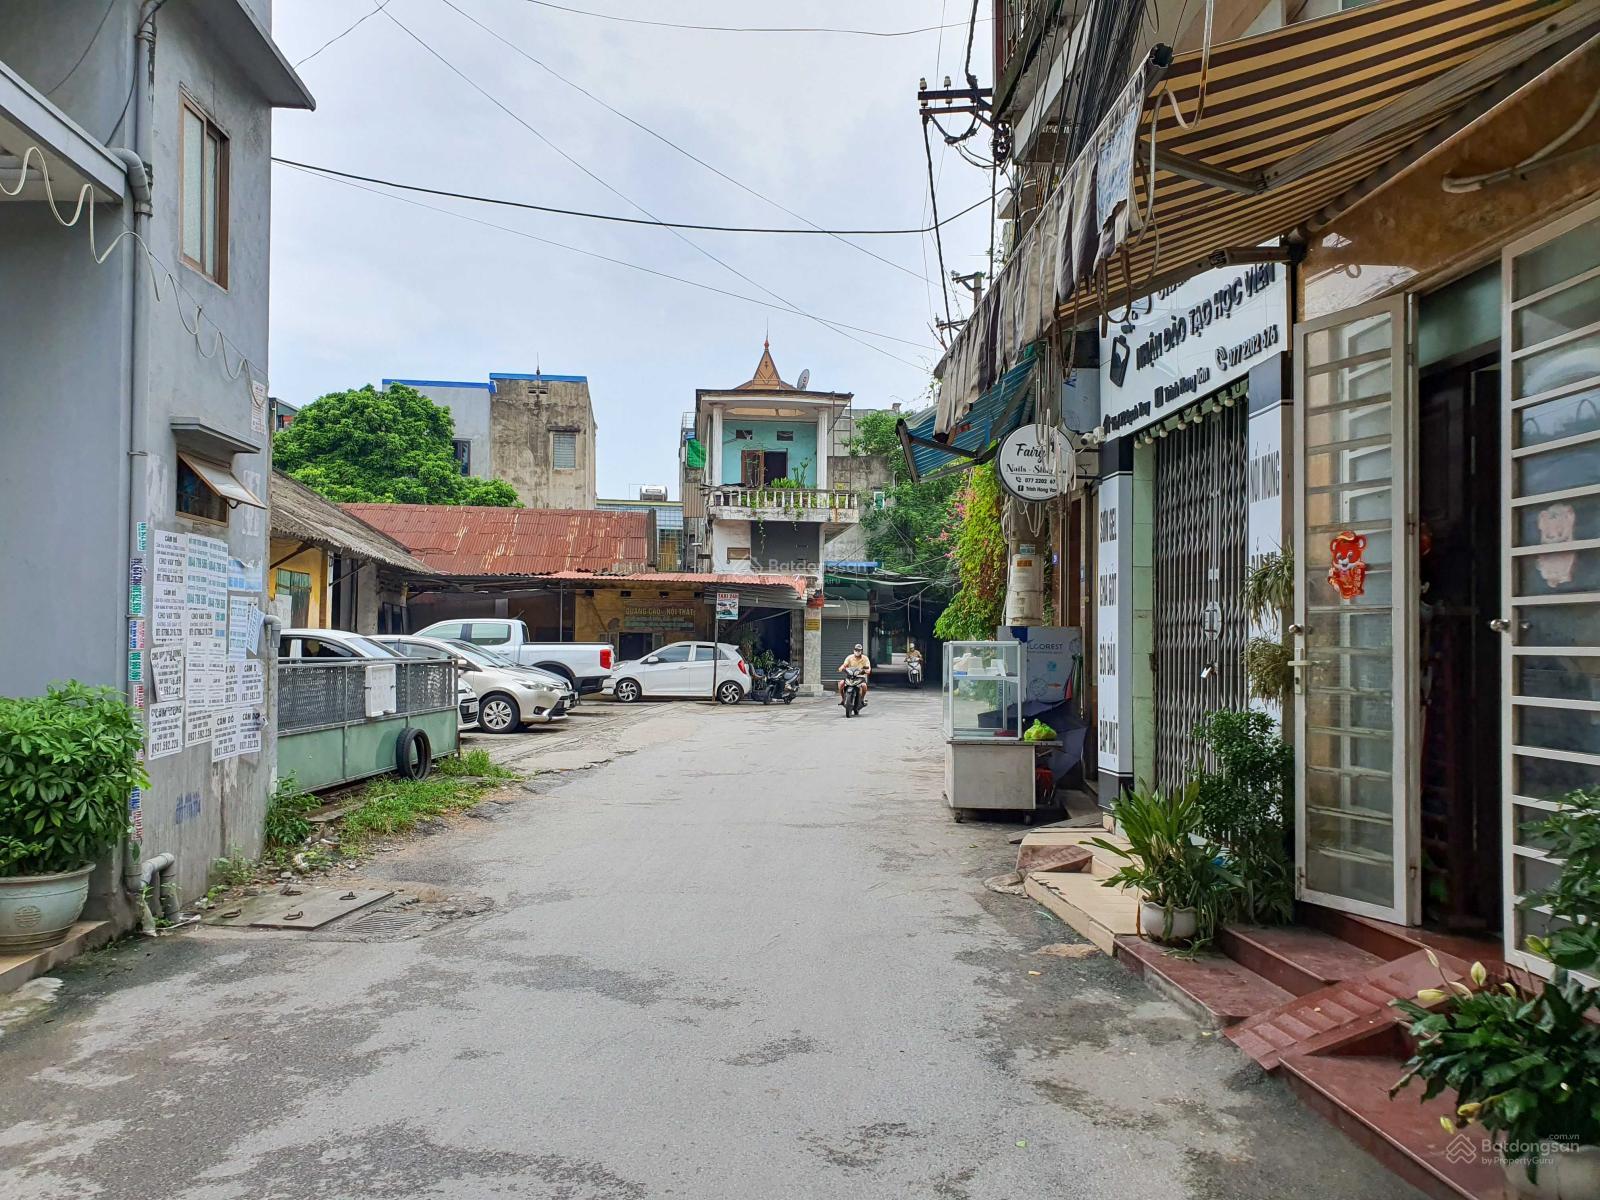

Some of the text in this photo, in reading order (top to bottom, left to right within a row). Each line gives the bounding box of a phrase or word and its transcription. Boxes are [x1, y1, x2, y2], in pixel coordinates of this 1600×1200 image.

[1188, 299, 1212, 337] TẠO
[1213, 277, 1242, 319] HỌC
[1006, 463, 1027, 473] Nails
[1262, 443, 1280, 500] MÓNG
